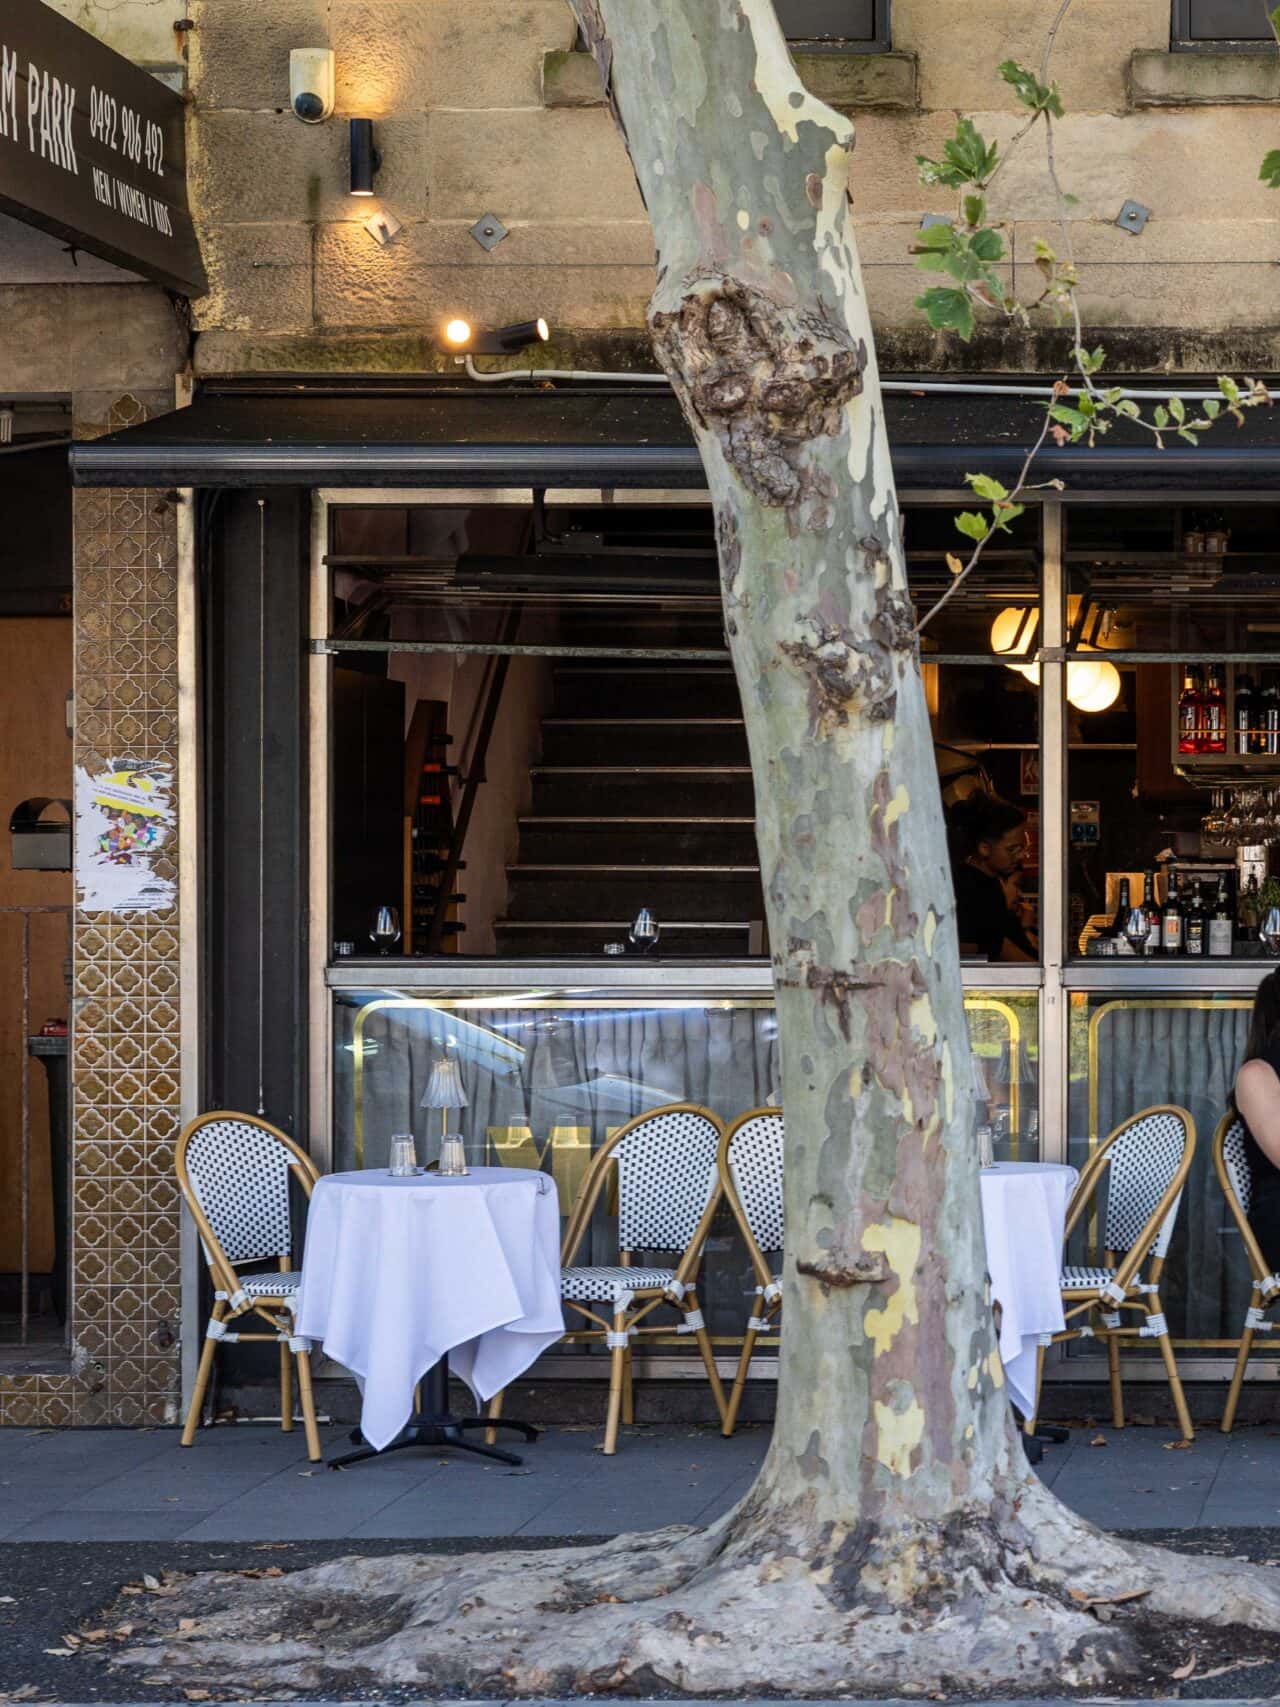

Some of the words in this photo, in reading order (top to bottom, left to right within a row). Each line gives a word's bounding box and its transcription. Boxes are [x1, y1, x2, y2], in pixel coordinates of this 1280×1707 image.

[0, 45, 18, 142] M
[28, 62, 78, 175] PARK
[90, 85, 118, 150] 0492
[121, 105, 142, 165] 906
[145, 119, 165, 178] 492
[92, 166, 112, 206] MEN
[117, 181, 148, 225] WOMEN
[154, 199, 173, 238] KIDS
